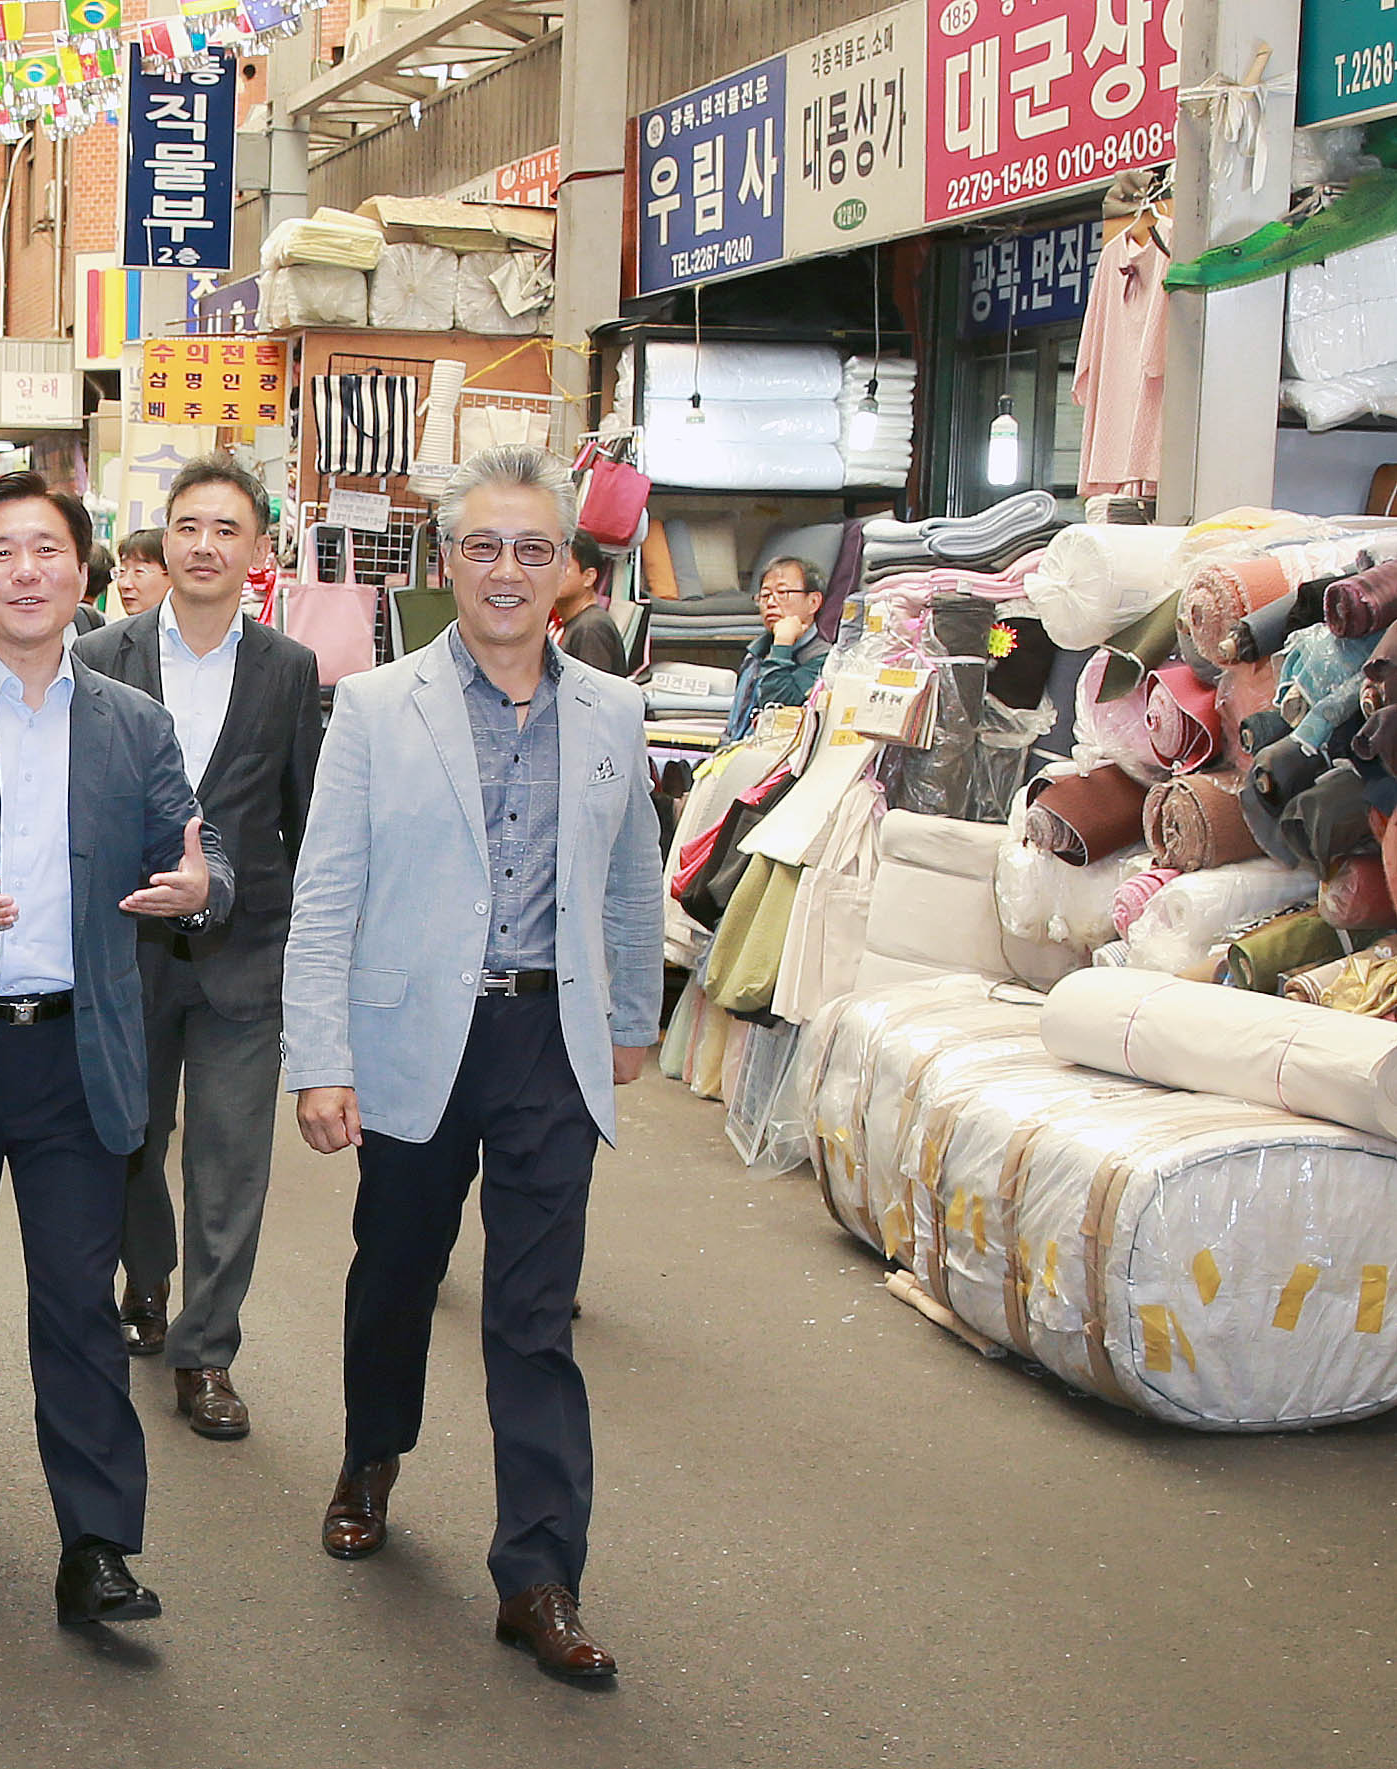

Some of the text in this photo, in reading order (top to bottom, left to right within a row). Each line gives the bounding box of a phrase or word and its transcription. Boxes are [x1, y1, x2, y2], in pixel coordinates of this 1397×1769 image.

[946, 4, 971, 32] 185
[802, 67, 907, 192] 대동상가
[143, 93, 216, 243] 직물부
[647, 117, 778, 246] 우림사
[947, 154, 1049, 210] 2279-1548
[157, 247, 202, 266] 2층
[149, 344, 280, 366] 수의전문
